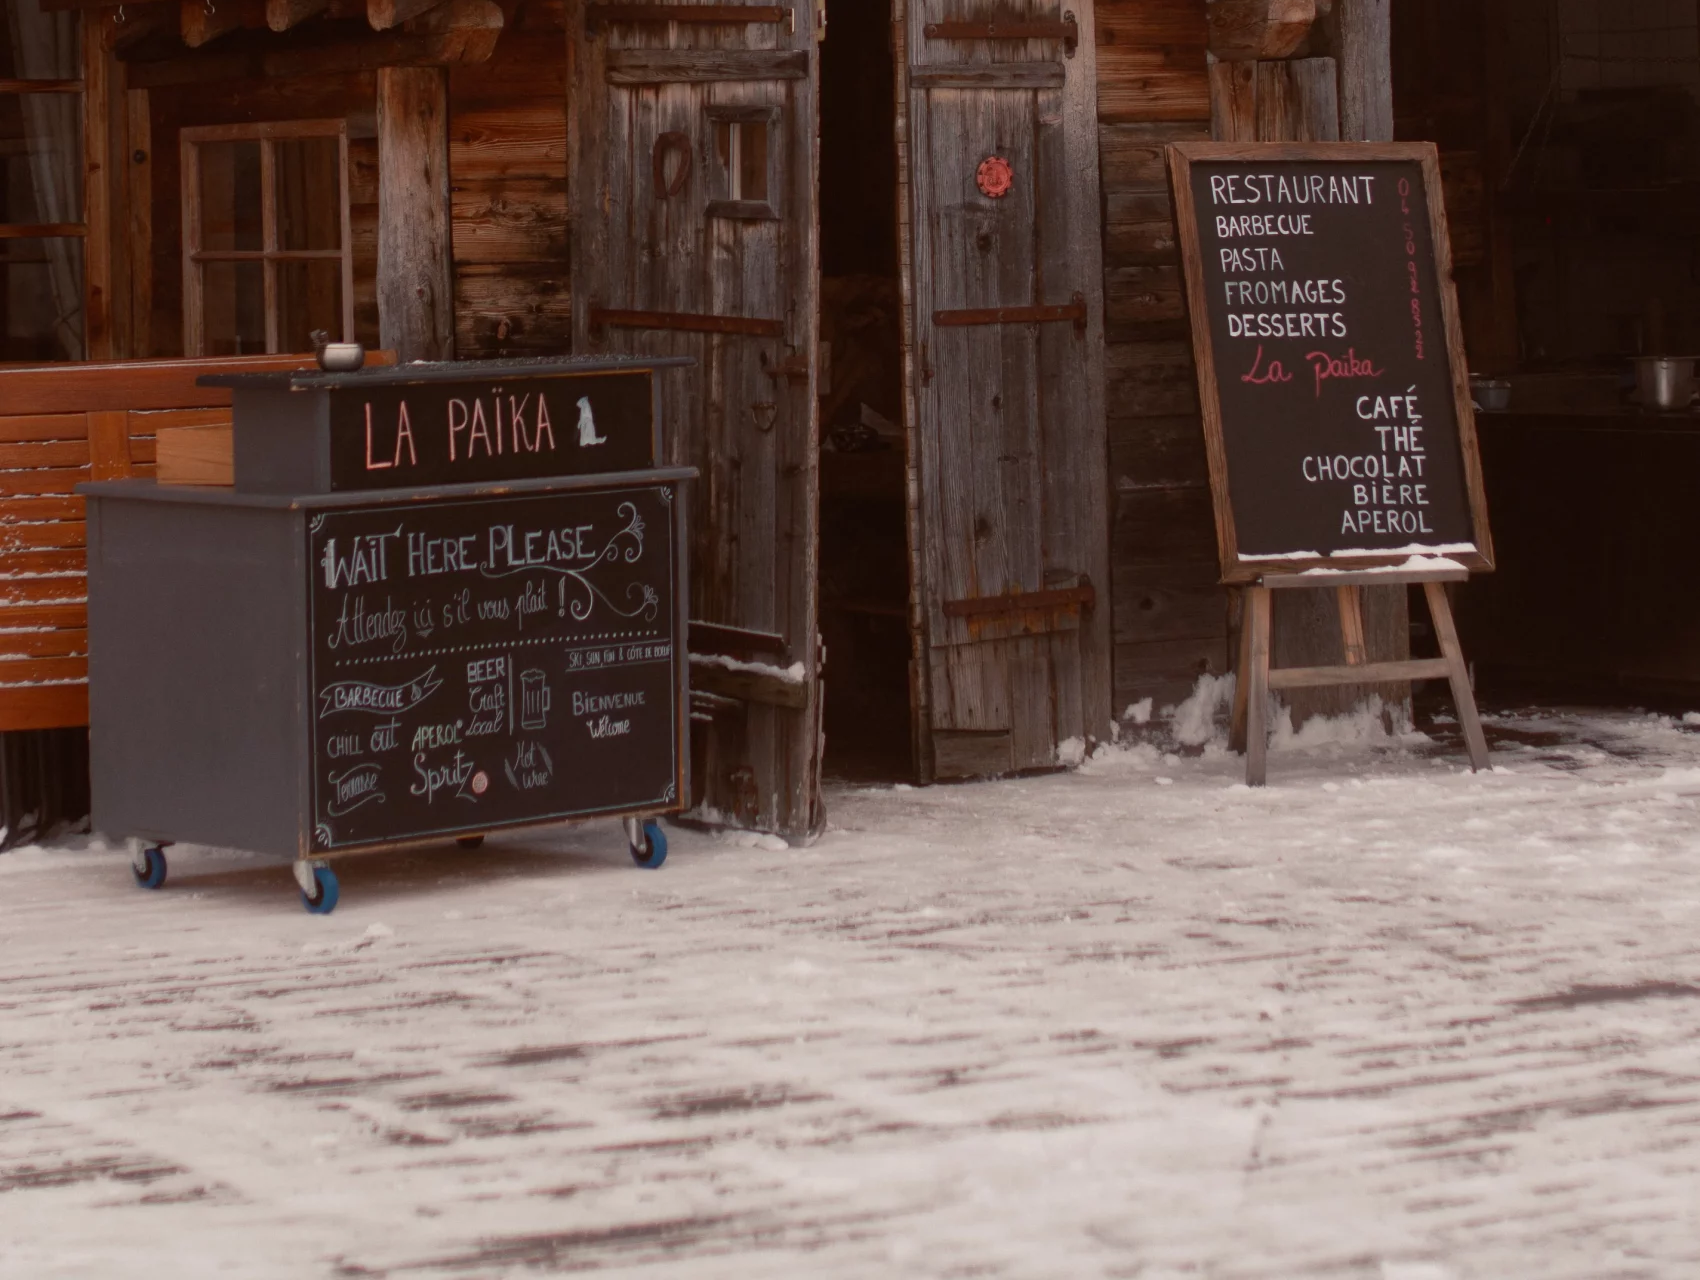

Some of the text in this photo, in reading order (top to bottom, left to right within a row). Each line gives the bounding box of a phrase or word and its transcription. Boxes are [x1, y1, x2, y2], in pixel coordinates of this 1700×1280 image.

[1210, 175, 1376, 205] RESTAURANT
[1216, 215, 1314, 238] BARBECUE
[1219, 248, 1284, 272] PASTA
[1224, 279, 1345, 305] FROMAGES
[1228, 313, 1347, 338] DESSERTS
[1241, 344, 1293, 384] La
[1356, 385, 1422, 420] CAFÉ
[365, 387, 555, 470] LA PAÏKA
[1374, 420, 1424, 452] THÉ
[1302, 455, 1427, 482] CHOCOLAT
[1341, 511, 1433, 534] APEROL
[407, 534, 478, 577] HERE
[488, 524, 596, 568] PLEASE
[328, 592, 406, 653] Attendez
[413, 599, 434, 628] ici
[443, 588, 471, 628] s'il
[477, 596, 510, 621] vous
[467, 656, 506, 683] BEER
[334, 686, 404, 708] BARBECUE
[469, 683, 506, 714] Craft
[572, 691, 646, 716] BIENVENUE
[465, 710, 503, 736] Local
[586, 715, 631, 739] Welcome
[327, 716, 401, 758] CHILL out
[513, 740, 536, 771] Hot
